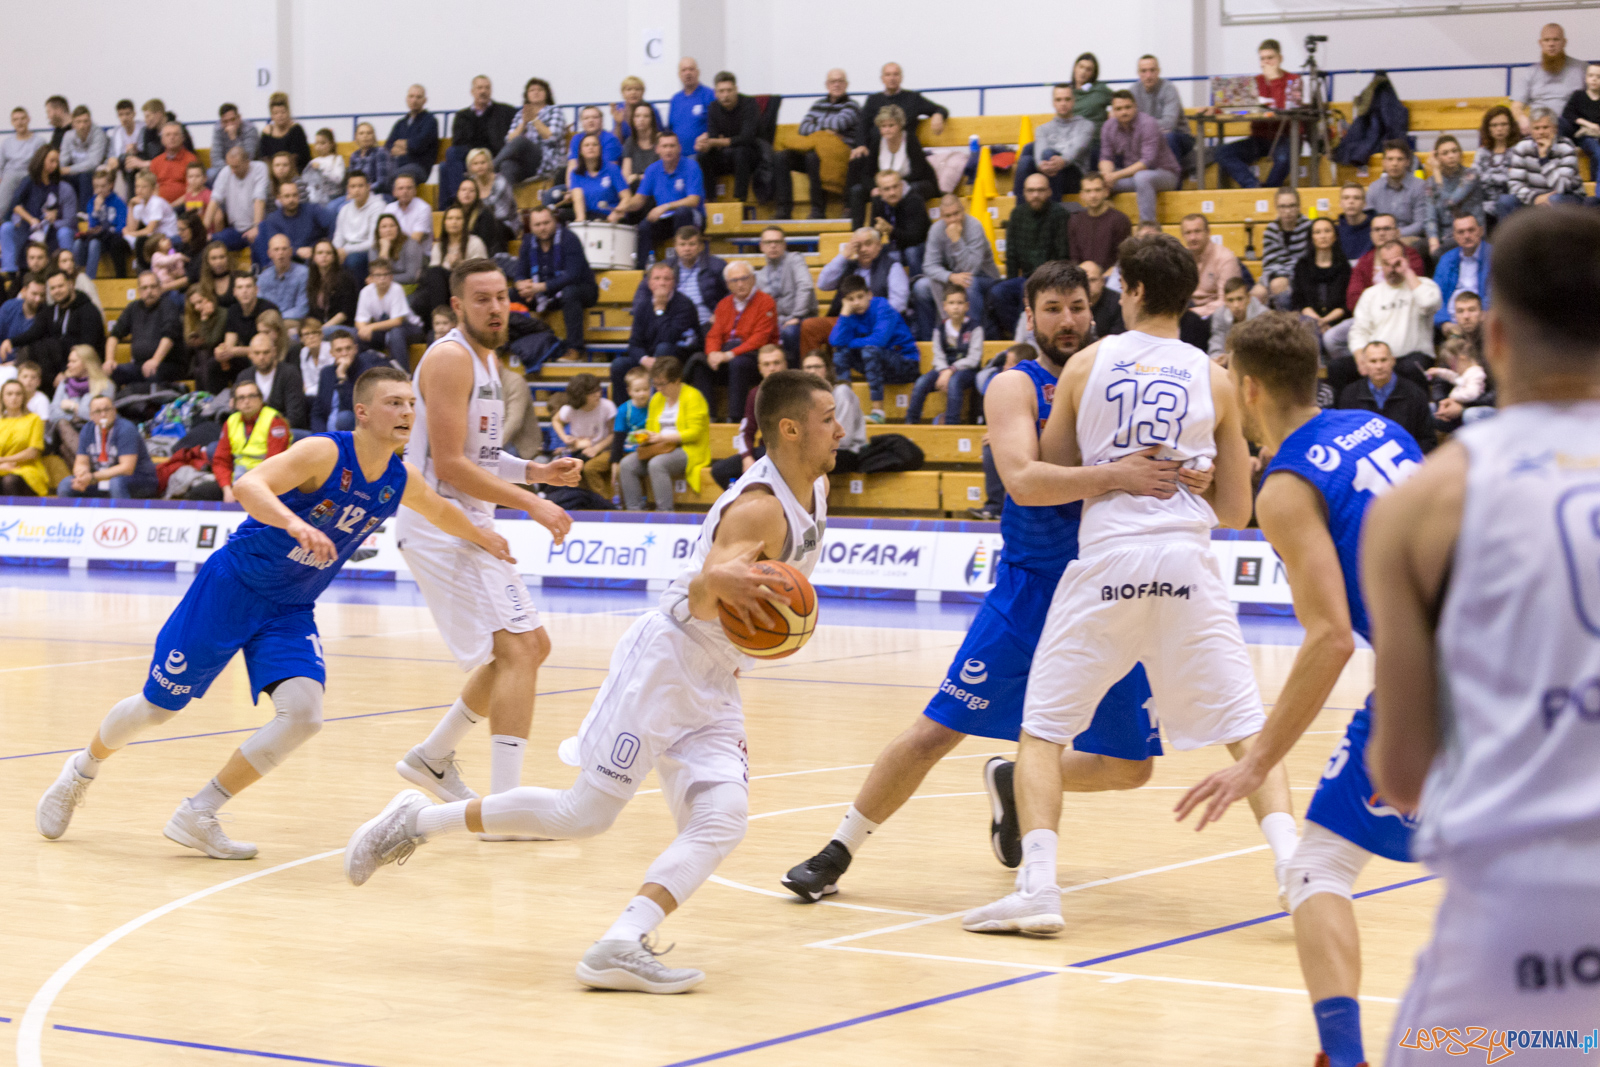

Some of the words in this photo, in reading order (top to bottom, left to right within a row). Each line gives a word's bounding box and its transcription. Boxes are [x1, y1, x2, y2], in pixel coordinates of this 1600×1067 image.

[645, 38, 662, 59] C
[257, 68, 270, 87] D
[1135, 363, 1192, 379] funclub
[1106, 379, 1188, 450] 13
[1333, 417, 1388, 451] Energa
[17, 520, 85, 538] funclub
[335, 504, 367, 535] 12
[100, 525, 129, 542] KIA
[147, 526, 190, 543] DELIK
[820, 541, 921, 567] IOFARM
[151, 664, 192, 696] Energa
[940, 678, 990, 711] Energa
[610, 732, 641, 770] 0
